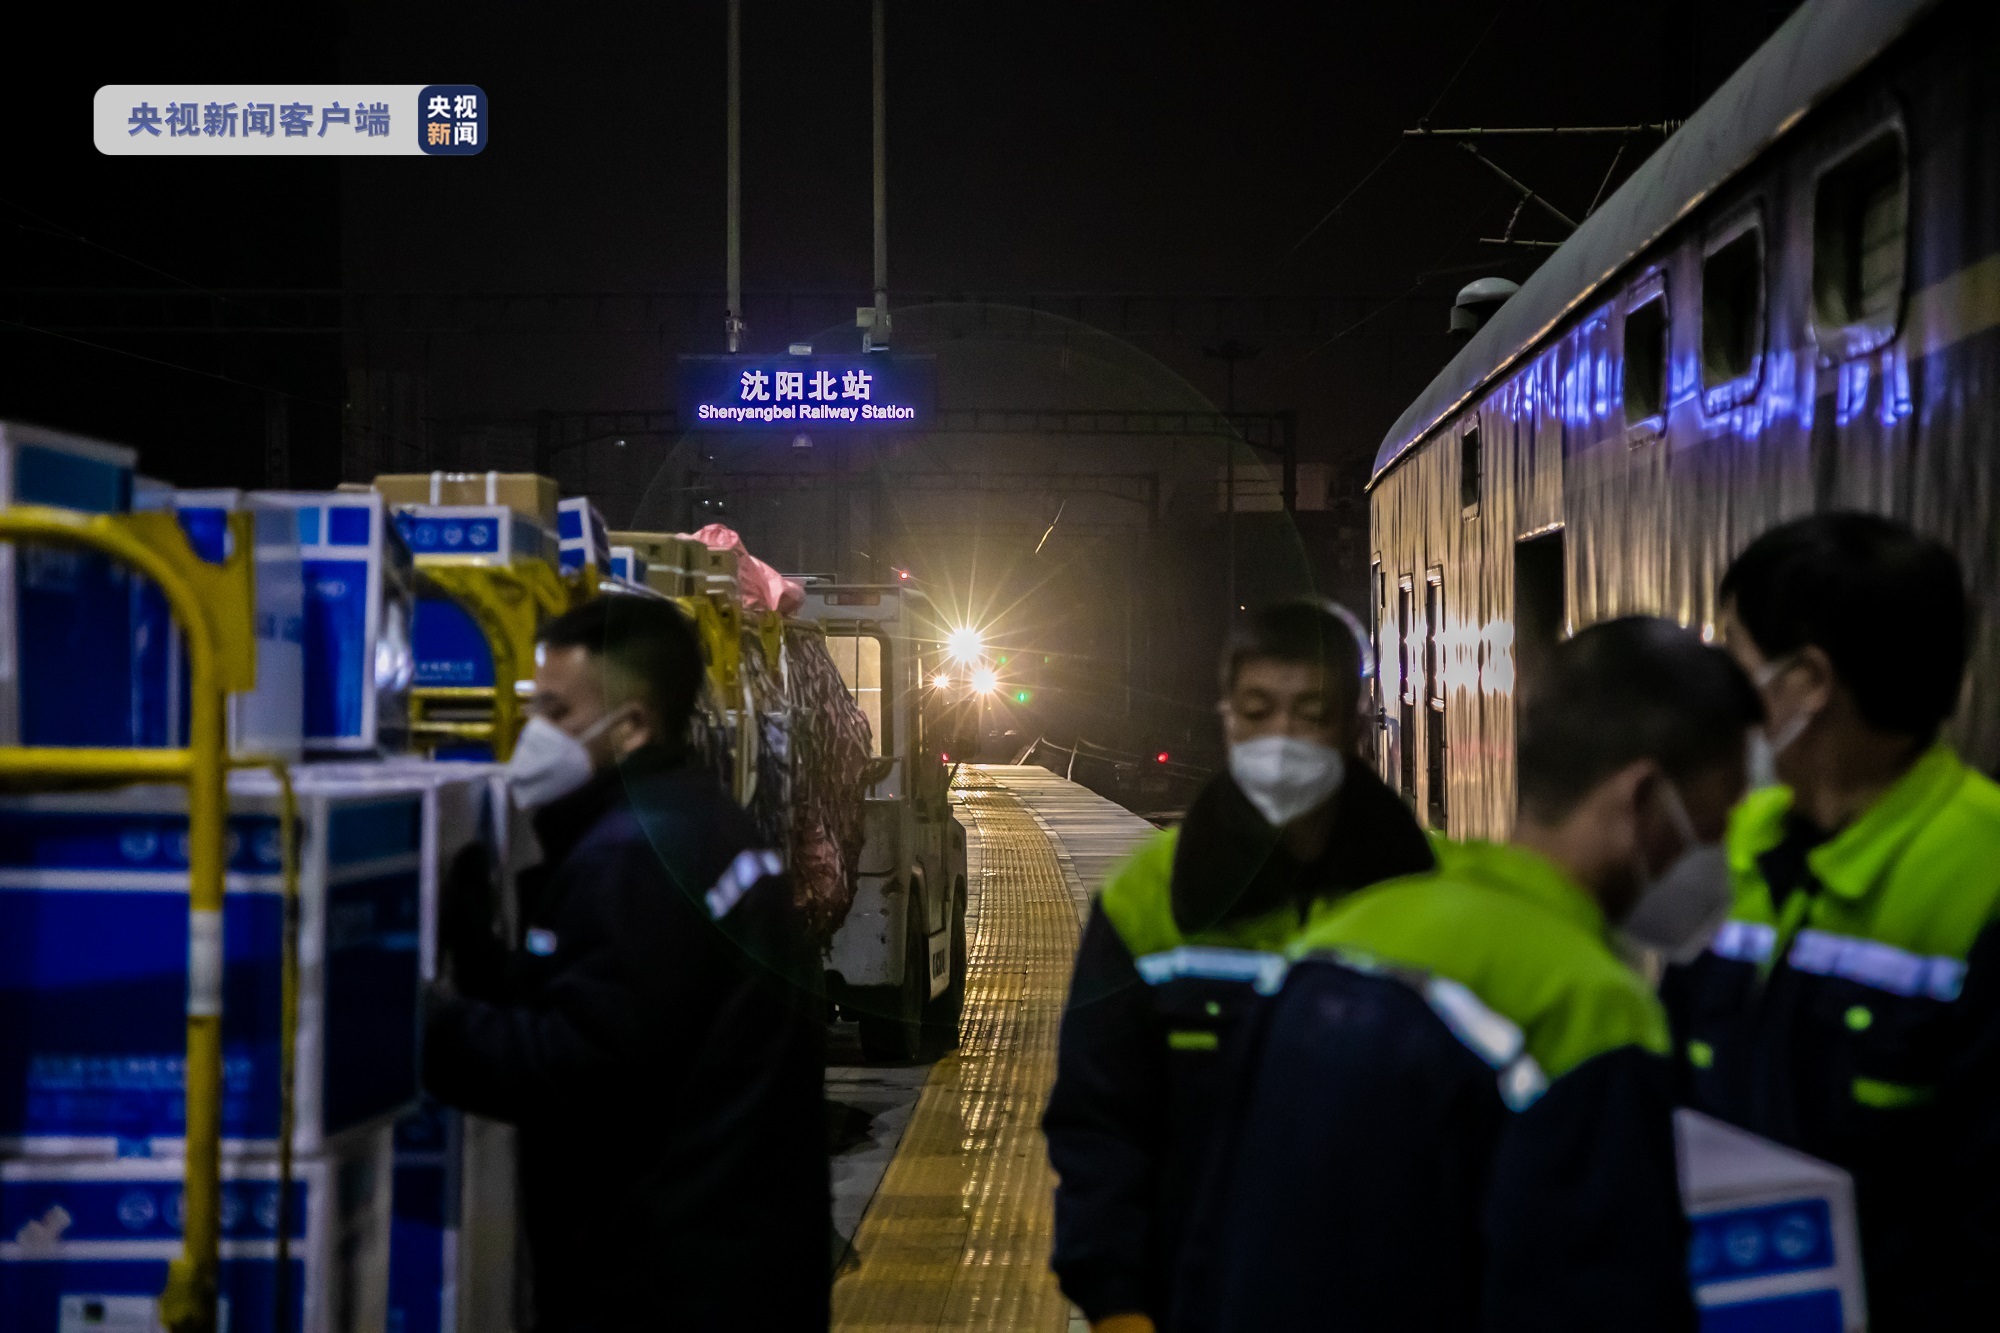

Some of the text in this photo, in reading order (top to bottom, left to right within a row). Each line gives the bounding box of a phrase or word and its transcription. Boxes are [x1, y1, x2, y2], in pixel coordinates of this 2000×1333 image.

[740, 370, 873, 401] 沈阳北站
[698, 404, 915, 421] Shenyangbei Railway Station
